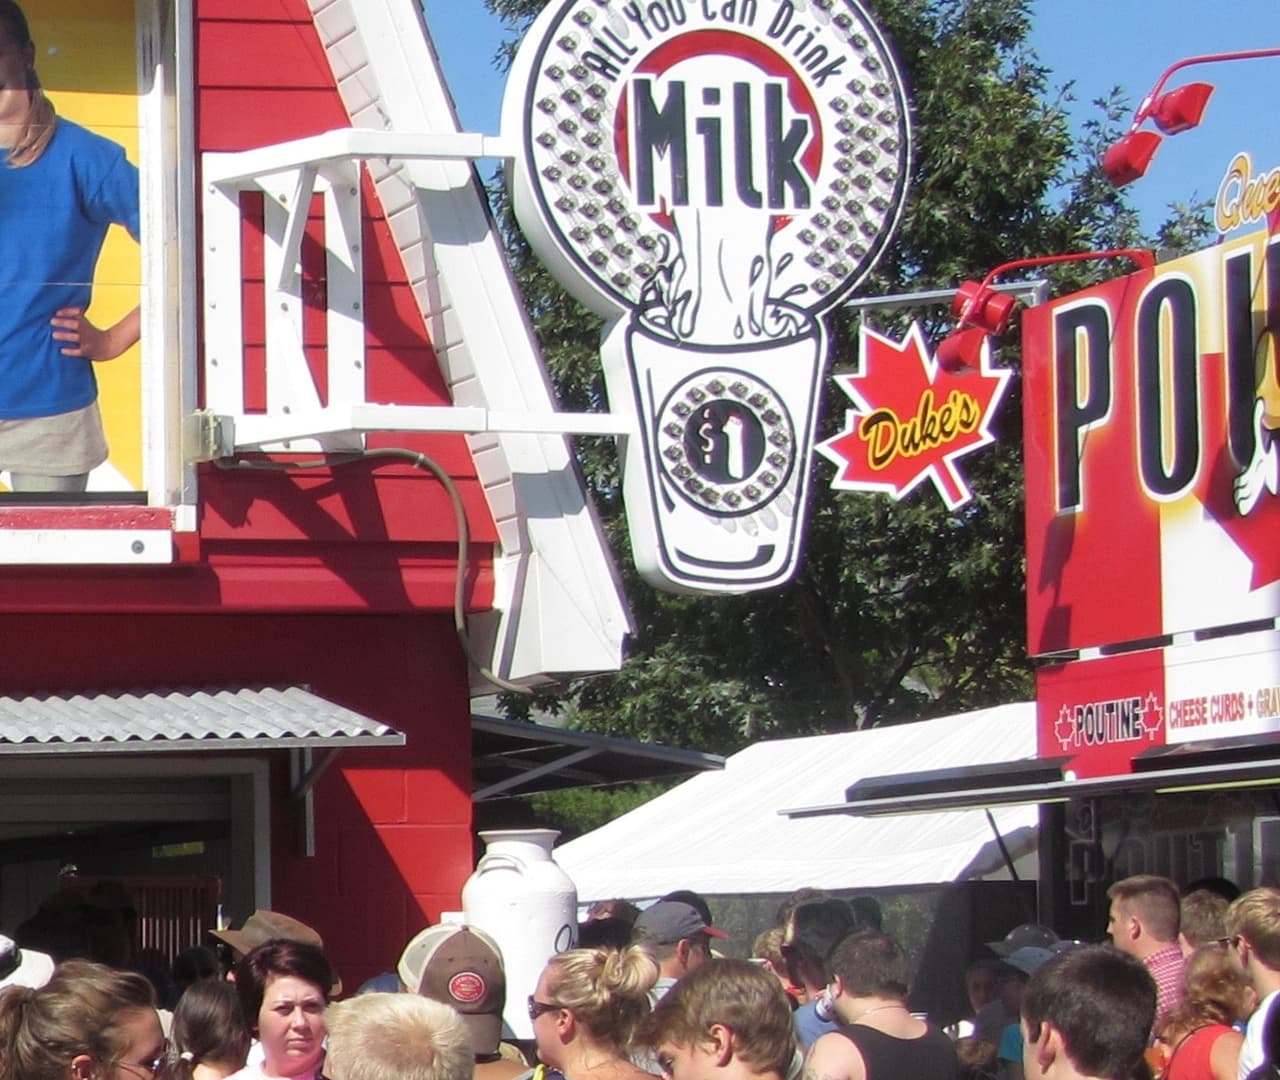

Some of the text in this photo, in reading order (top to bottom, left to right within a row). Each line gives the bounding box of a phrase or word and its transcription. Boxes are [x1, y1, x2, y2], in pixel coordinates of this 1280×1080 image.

[766, 0, 848, 88] Drink
[633, 78, 811, 209] Milk
[863, 388, 980, 469] Duke's
[1074, 698, 1143, 747] POUTINE
[1169, 696, 1208, 729] CHEESE
[1210, 691, 1245, 724] CURDS
